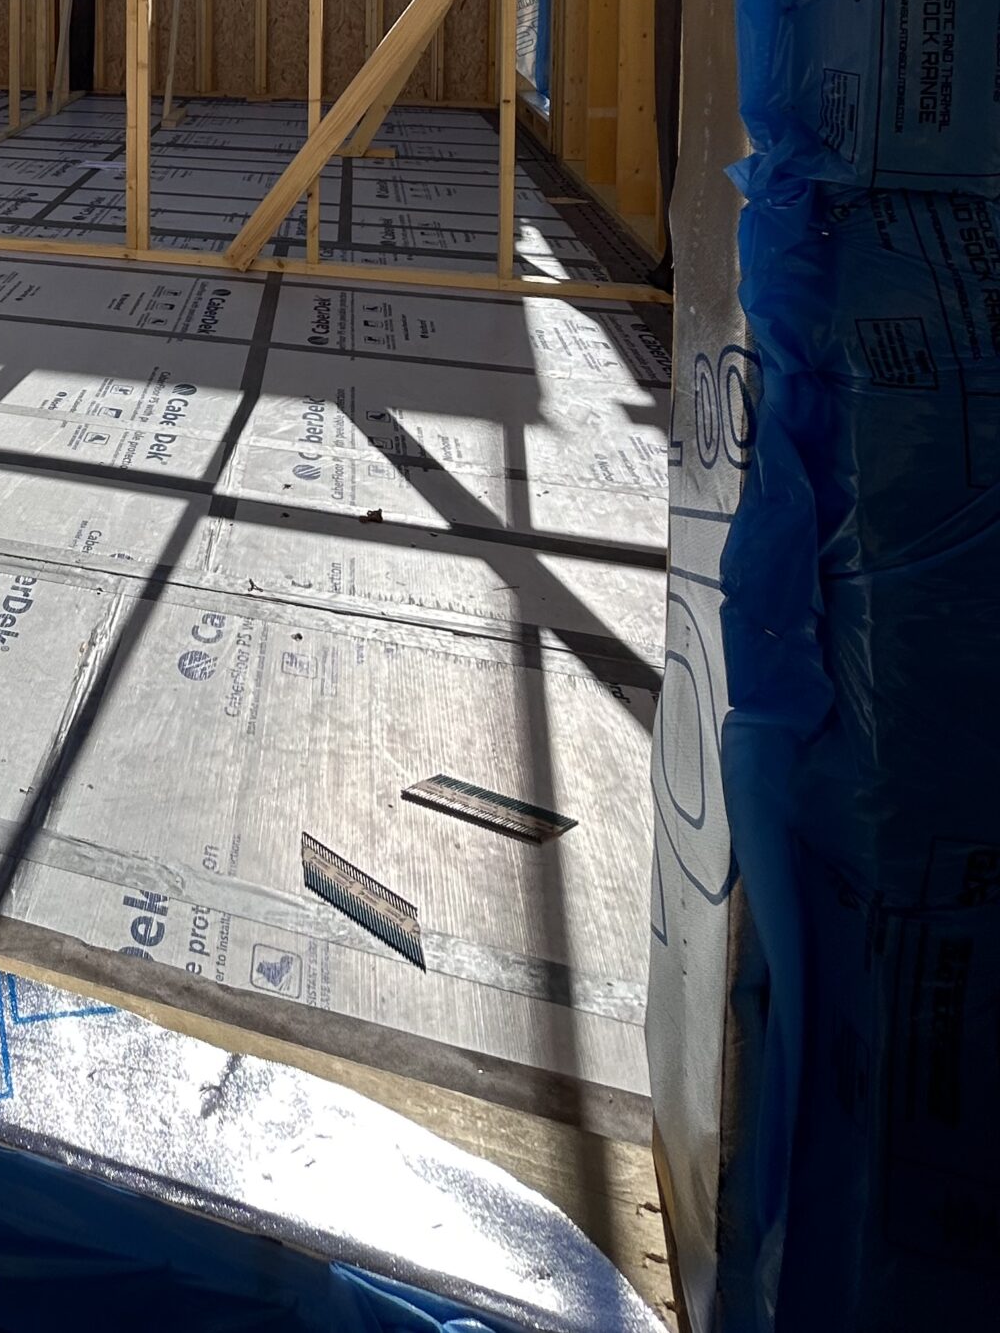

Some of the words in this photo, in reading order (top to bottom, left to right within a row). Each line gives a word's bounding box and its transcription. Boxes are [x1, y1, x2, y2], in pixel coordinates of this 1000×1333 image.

[919, 53, 938, 124] RANGE
[938, 64, 953, 132] THERMAL
[200, 297, 225, 335] CaberDek
[312, 295, 331, 335] CaberDek
[299, 395, 325, 460] CberDek
[215, 953, 226, 967] to
